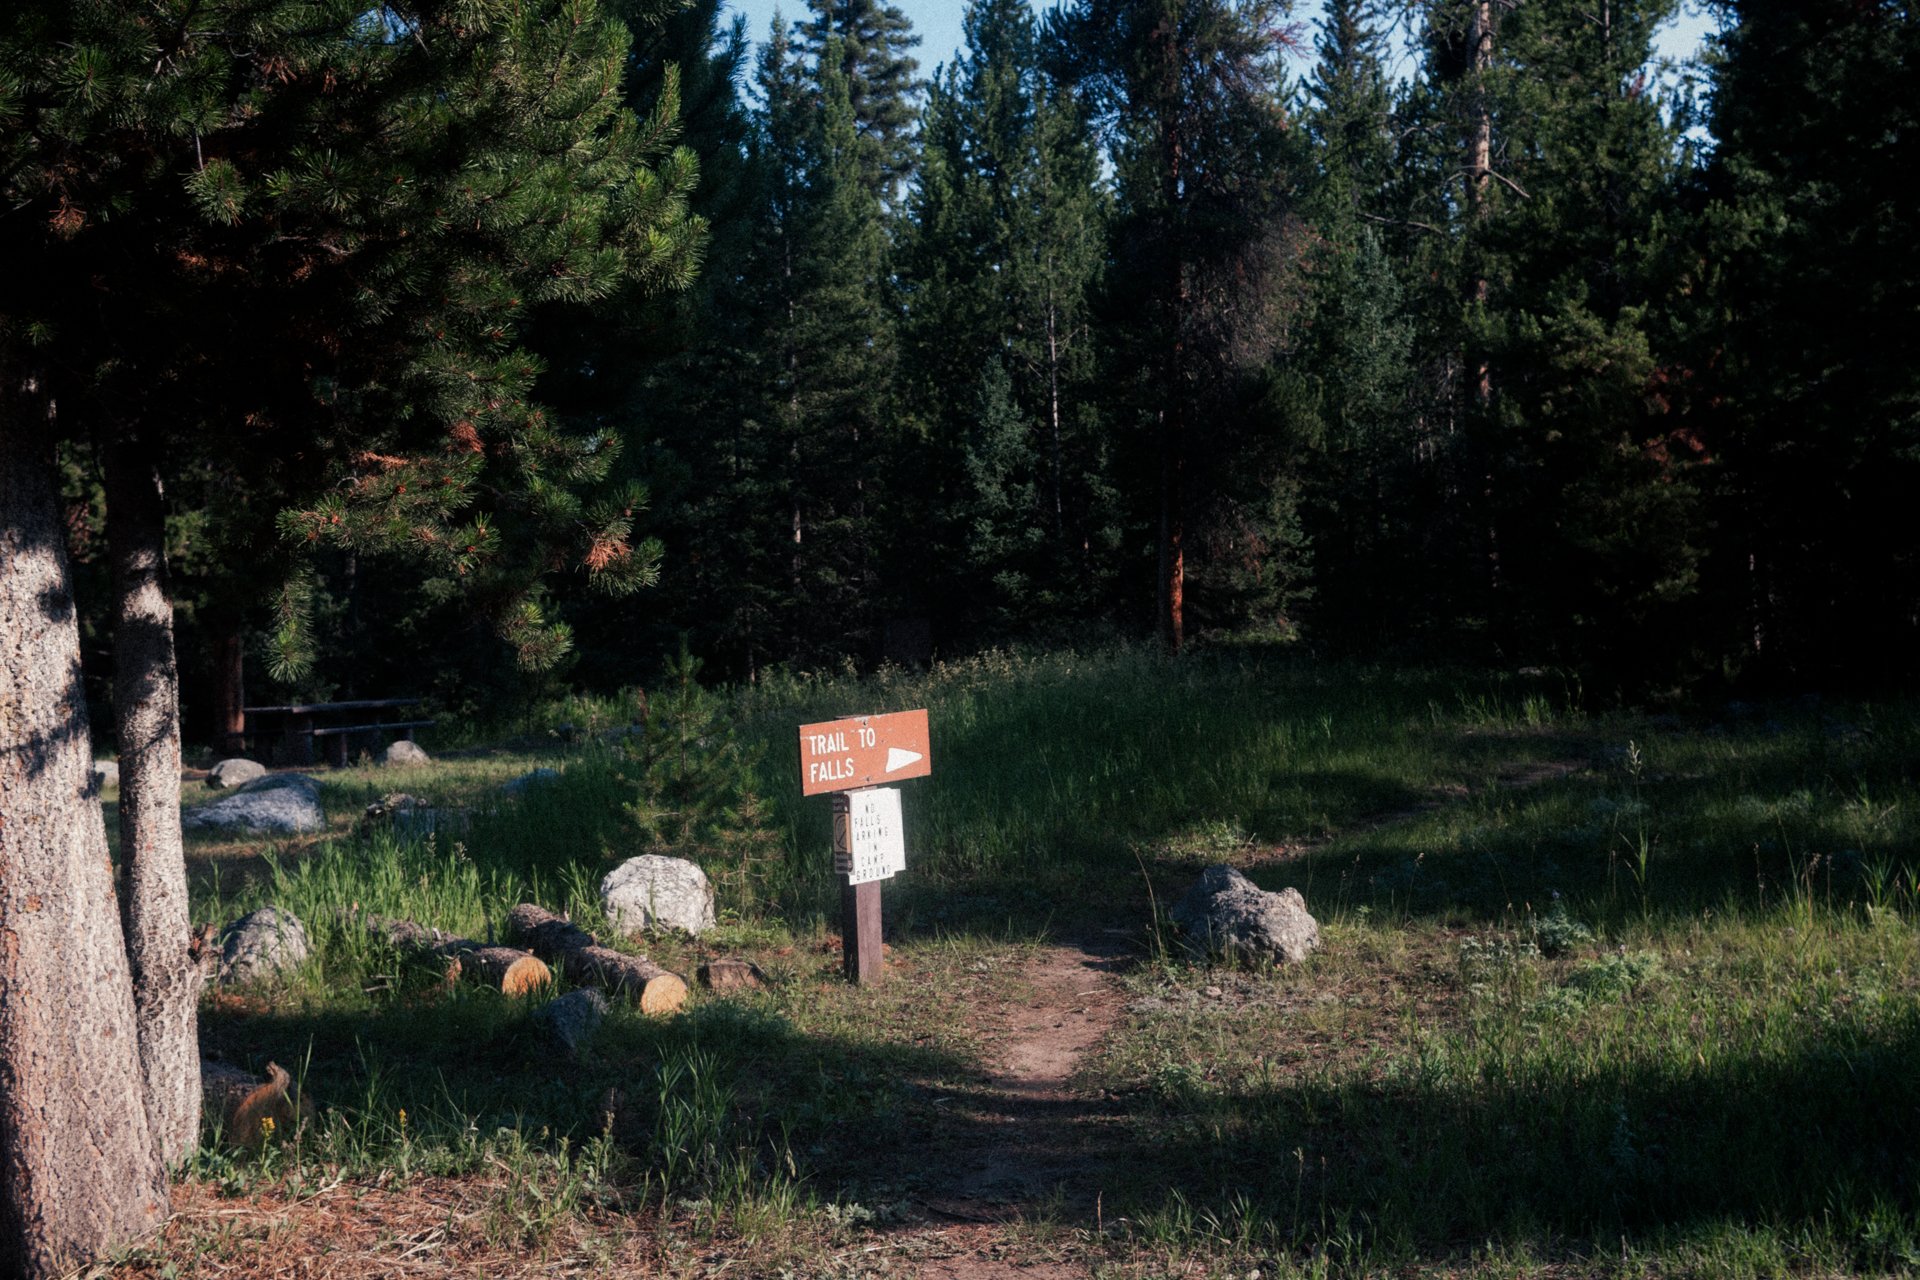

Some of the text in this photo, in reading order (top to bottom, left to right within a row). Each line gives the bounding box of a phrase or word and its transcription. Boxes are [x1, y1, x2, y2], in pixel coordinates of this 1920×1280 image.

[809, 727, 876, 755] TRAIL TO
[810, 757, 854, 783] FALLS
[855, 814, 880, 828] FALLS
[857, 864, 890, 881] GROUND
